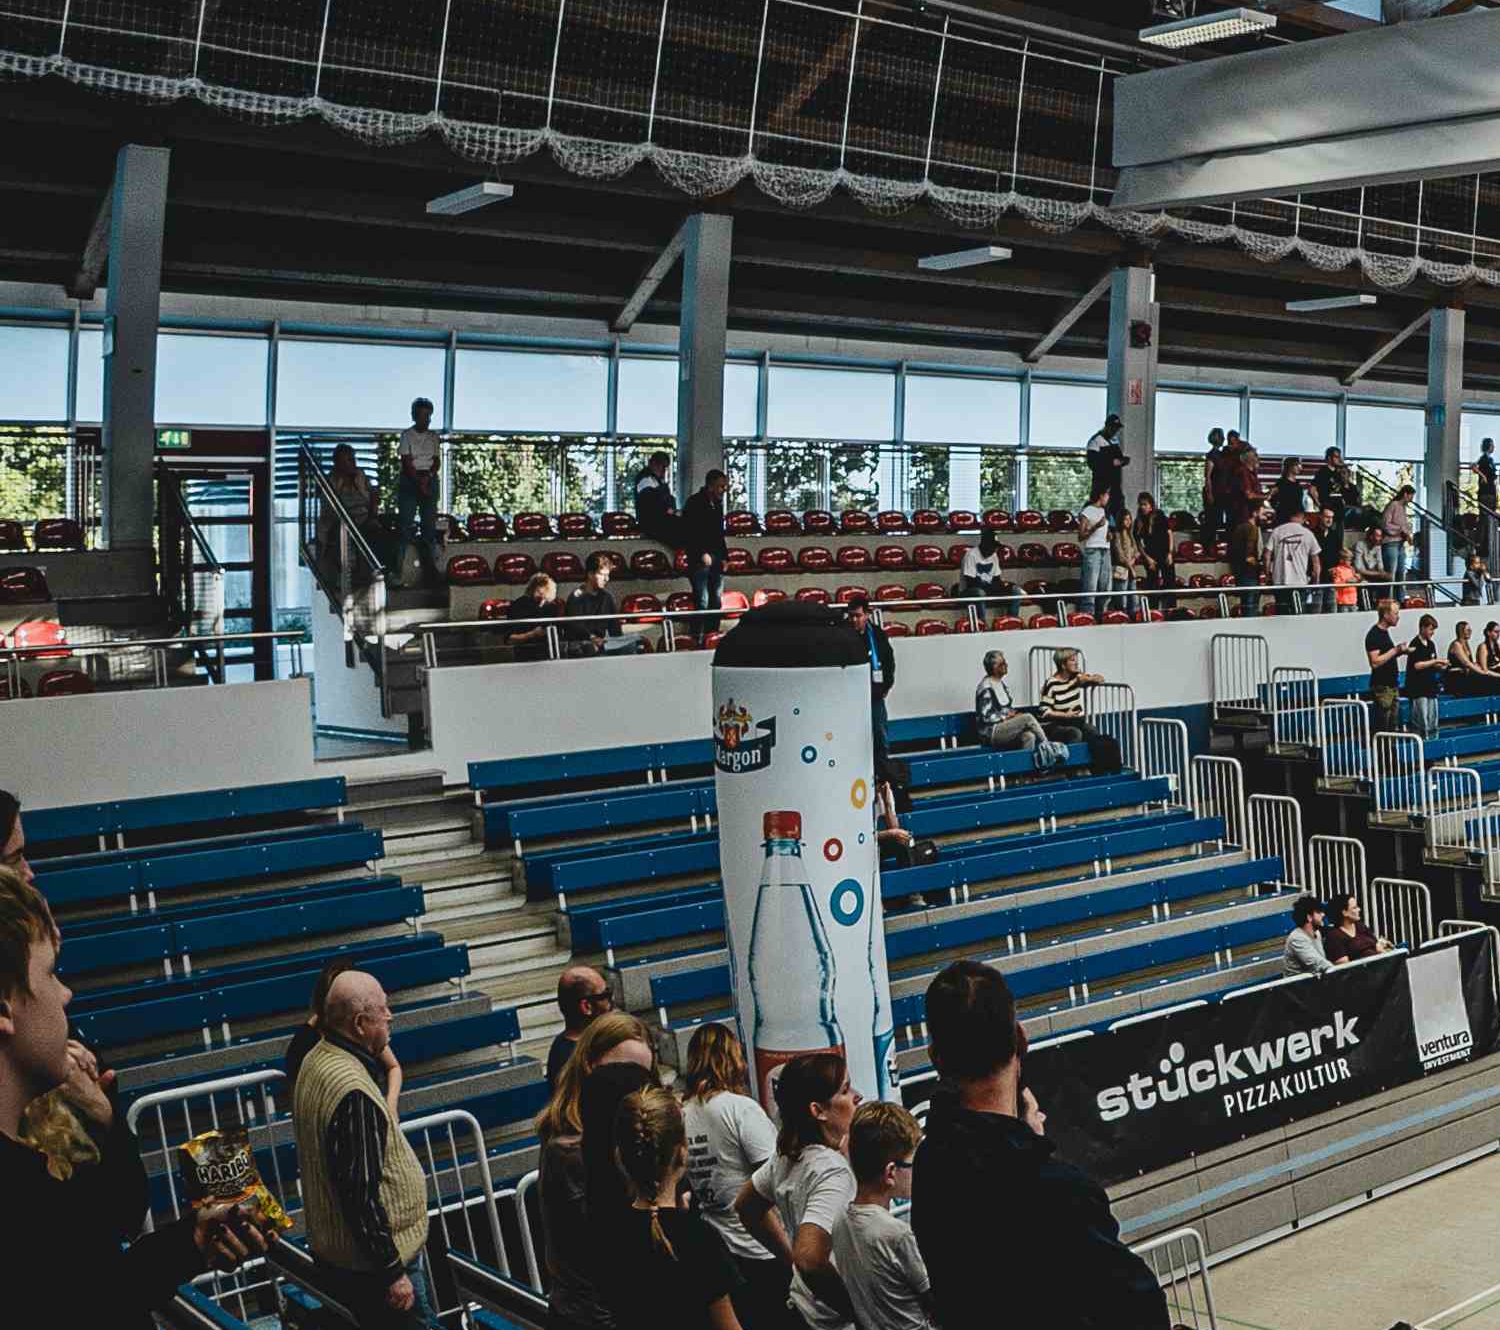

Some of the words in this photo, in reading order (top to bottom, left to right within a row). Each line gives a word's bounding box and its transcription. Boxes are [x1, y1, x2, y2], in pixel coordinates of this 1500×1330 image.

[1096, 1010, 1360, 1122] stückwerk
[1419, 1030, 1473, 1057] ventura
[1223, 1057, 1352, 1118] PIZZAKULTUR
